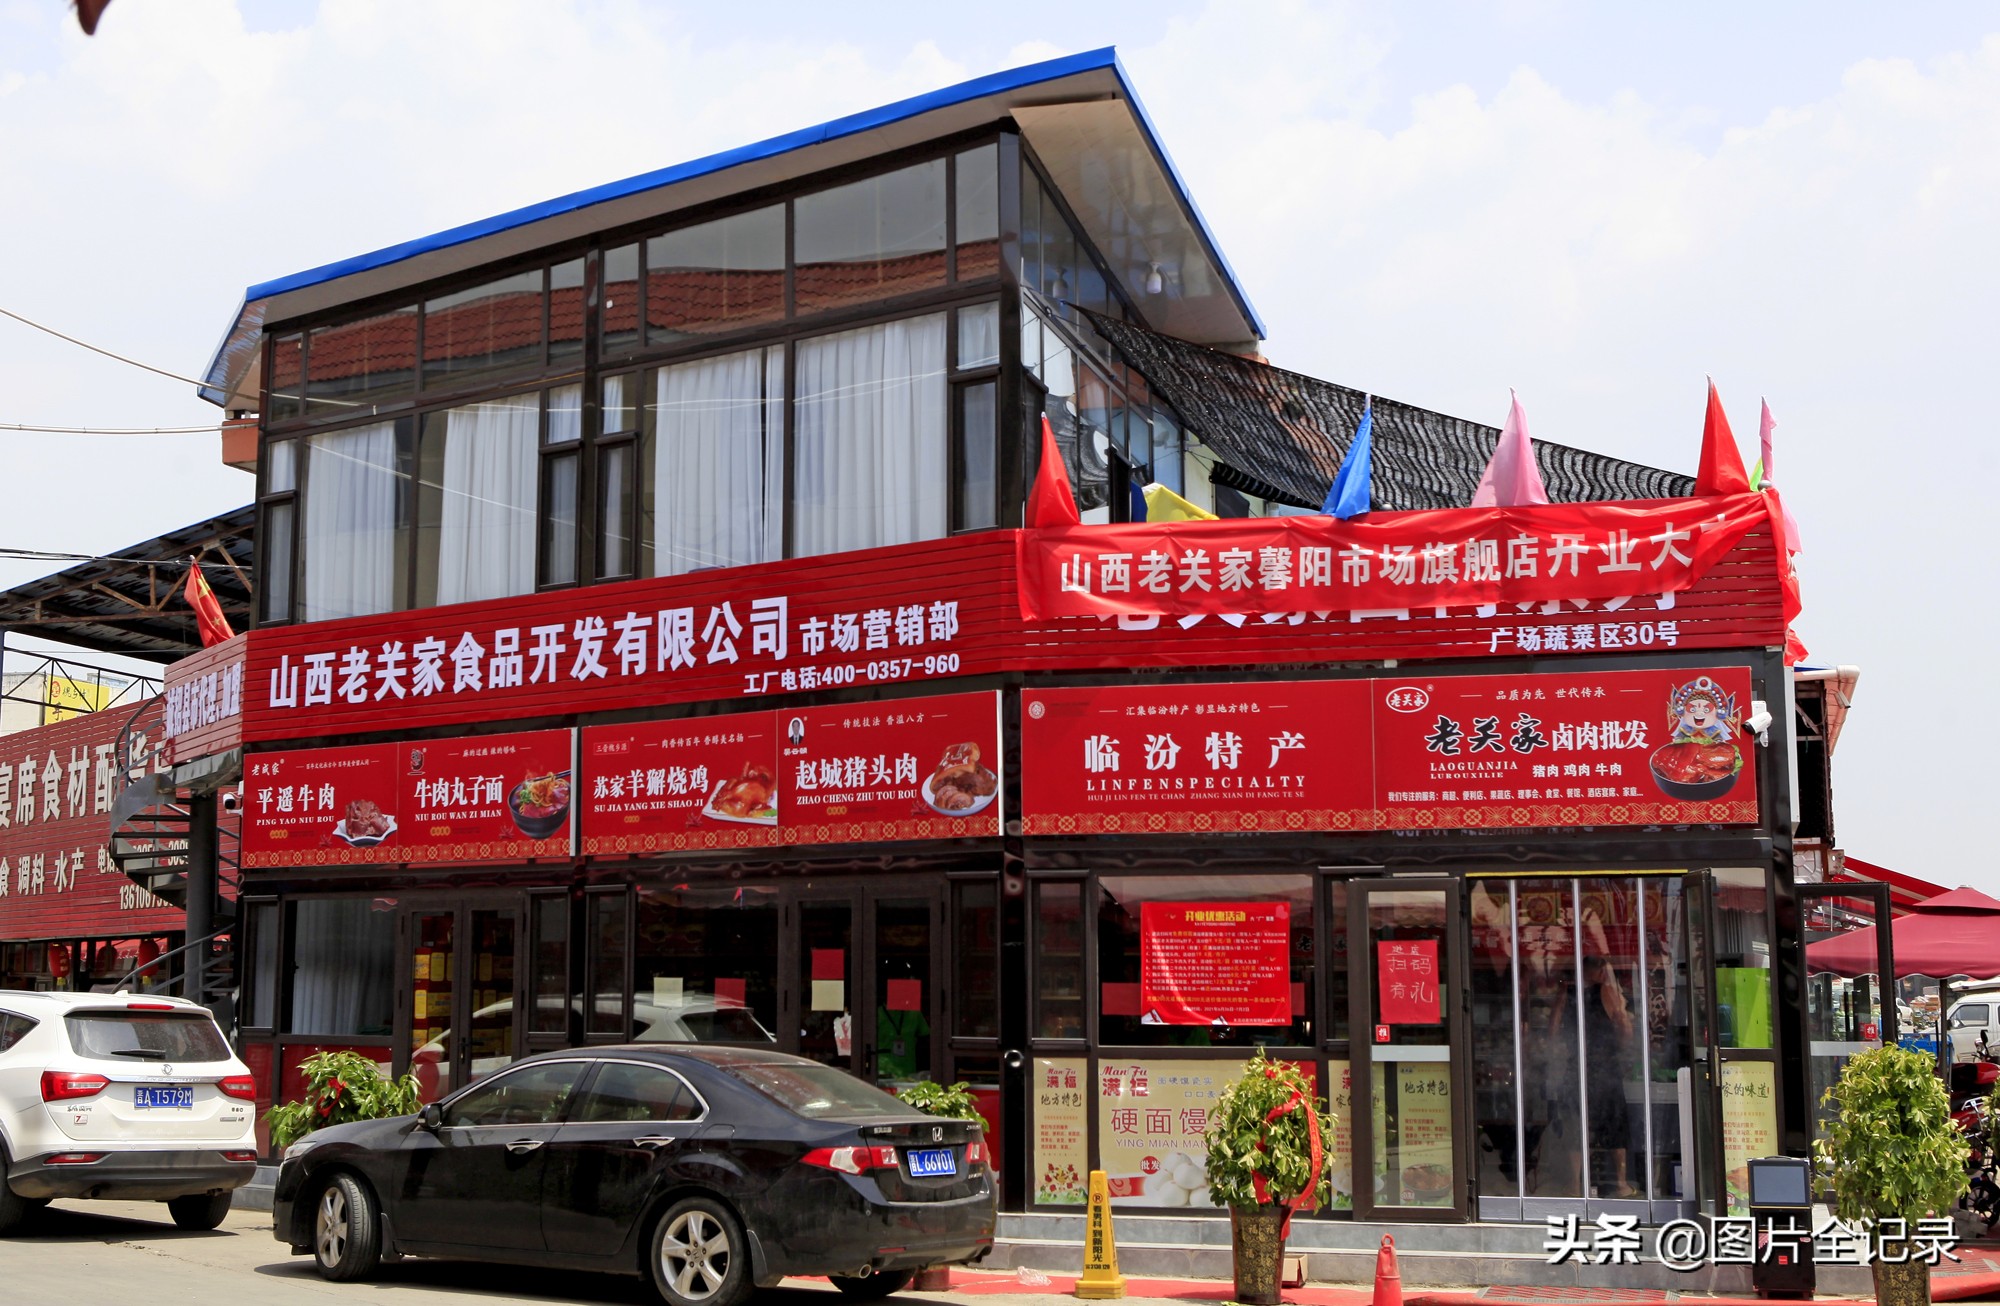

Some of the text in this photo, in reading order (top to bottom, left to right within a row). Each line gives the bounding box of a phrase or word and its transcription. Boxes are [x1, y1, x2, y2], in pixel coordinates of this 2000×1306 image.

[1489, 620, 1680, 653] 广场蔬菜区30号
[269, 596, 959, 708] 山西老关家食品开发有限公司 市场营销部
[1390, 694, 1425, 707] 老关家
[1496, 686, 1606, 701] 品质为先 世代传承
[1126, 702, 1261, 716] 汇集临汾特产 彰显地方特色
[843, 712, 925, 729] 传统技法 香溢八方
[1424, 713, 1649, 756] 老关家 卤肉批发
[1083, 731, 1306, 773] 临汾特产
[795, 752, 918, 791] 赵城猪头肉
[1430, 761, 1518, 772] LAOGUANJIA
[1532, 763, 1622, 778] 猪肉 鸡肉 牛肉
[593, 764, 709, 799] 苏家羊獬烧鸡
[1086, 775, 1307, 791] LINFENSPECIALTY
[1430, 772, 1504, 780] LUROUXILIE
[256, 783, 335, 814] 平遥牛肉
[414, 775, 504, 809] 牛肉丸子面
[796, 789, 918, 805] ZHAO CHENG ZHU TOU ROU
[1104, 794, 1112, 803] JI
[1257, 791, 1280, 799] FANG
[594, 799, 703, 813] SU JIA YANG XIE SHAO JI
[256, 815, 335, 826] PING YAO NIU ROU
[415, 809, 502, 822] NIU ROU WAN ZI MIAN
[18, 852, 45, 896] 调料
[54, 847, 85, 893] 水产
[1387, 956, 1432, 975] 扫码
[1390, 981, 1433, 1004] 有礼
[1100, 1065, 1147, 1079] Man Fu
[1046, 1075, 1077, 1089] 满福
[1102, 1077, 1149, 1097] 满福
[1404, 1080, 1449, 1096] 地方特色
[1040, 1091, 1082, 1107] 地方特色
[1110, 1107, 1226, 1136] 硬面馒
[1115, 1139, 1144, 1148] YING
[1148, 1138, 1178, 1149] MIAN
[1183, 1139, 1208, 1149] MAN
[1141, 1161, 1161, 1171] 批发
